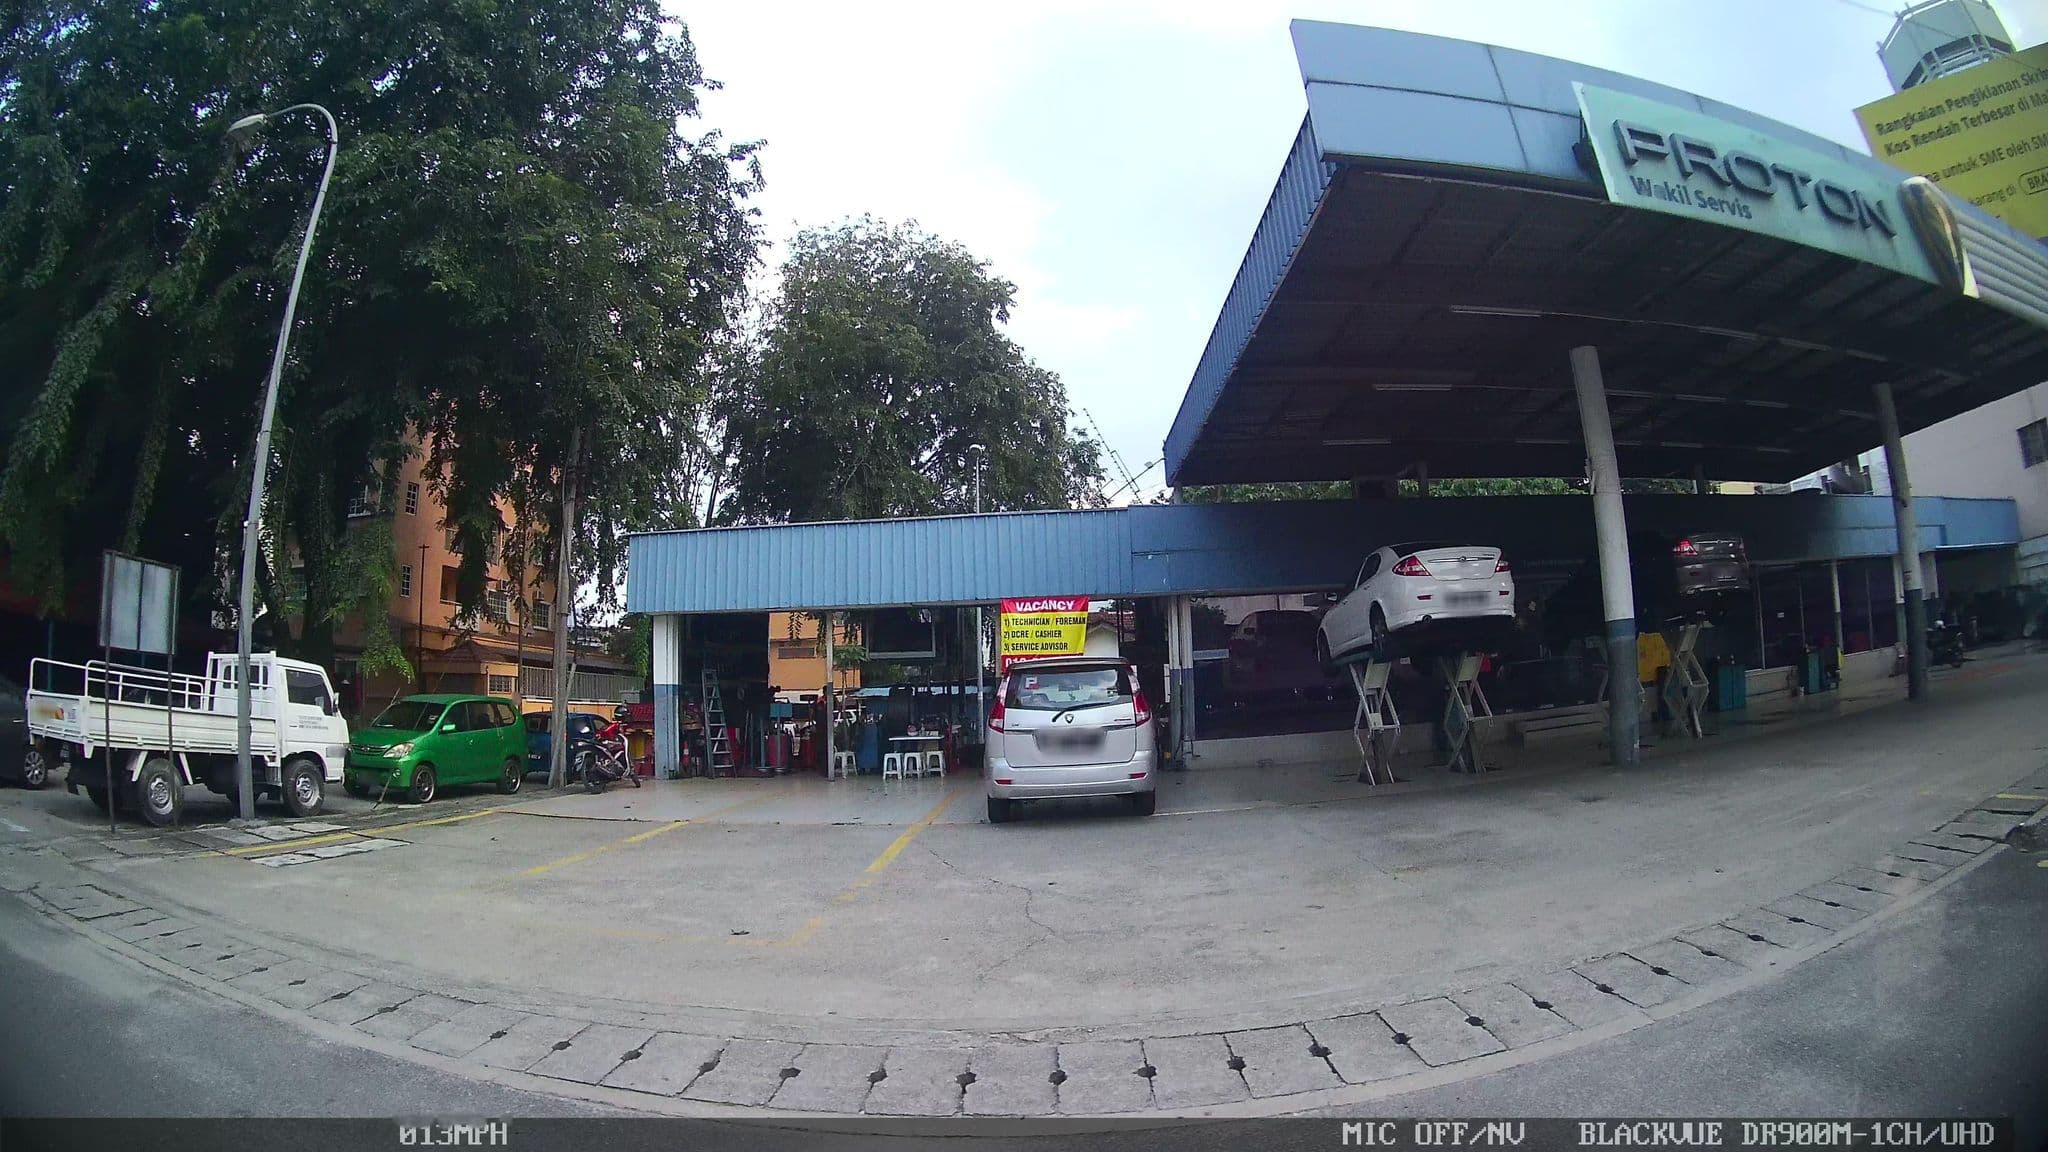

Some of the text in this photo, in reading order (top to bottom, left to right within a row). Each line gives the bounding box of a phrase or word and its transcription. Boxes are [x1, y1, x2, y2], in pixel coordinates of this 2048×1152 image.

[1875, 104, 1946, 136] Rangkaian
[1945, 79, 2021, 112] Pengiklanan
[1884, 142, 1912, 157] Kos
[1911, 121, 1962, 147] Rendah
[1961, 103, 2016, 130] Terbesar
[2017, 95, 2031, 112] di
[1943, 156, 1979, 178] untuk
[1979, 147, 2006, 167] SME
[2006, 142, 2032, 158] oleh
[1613, 119, 1897, 239] PROTON
[1629, 175, 1753, 220] Wakil Servis
[1011, 617, 1050, 626] TECHNICIAN
[1055, 616, 1086, 625] FOREMAN
[1015, 600, 1074, 612] VACANCY
[1011, 642, 1039, 651] SERVICE
[1040, 642, 1068, 650] ADVISOR
[1035, 629, 1062, 638] CASHIER
